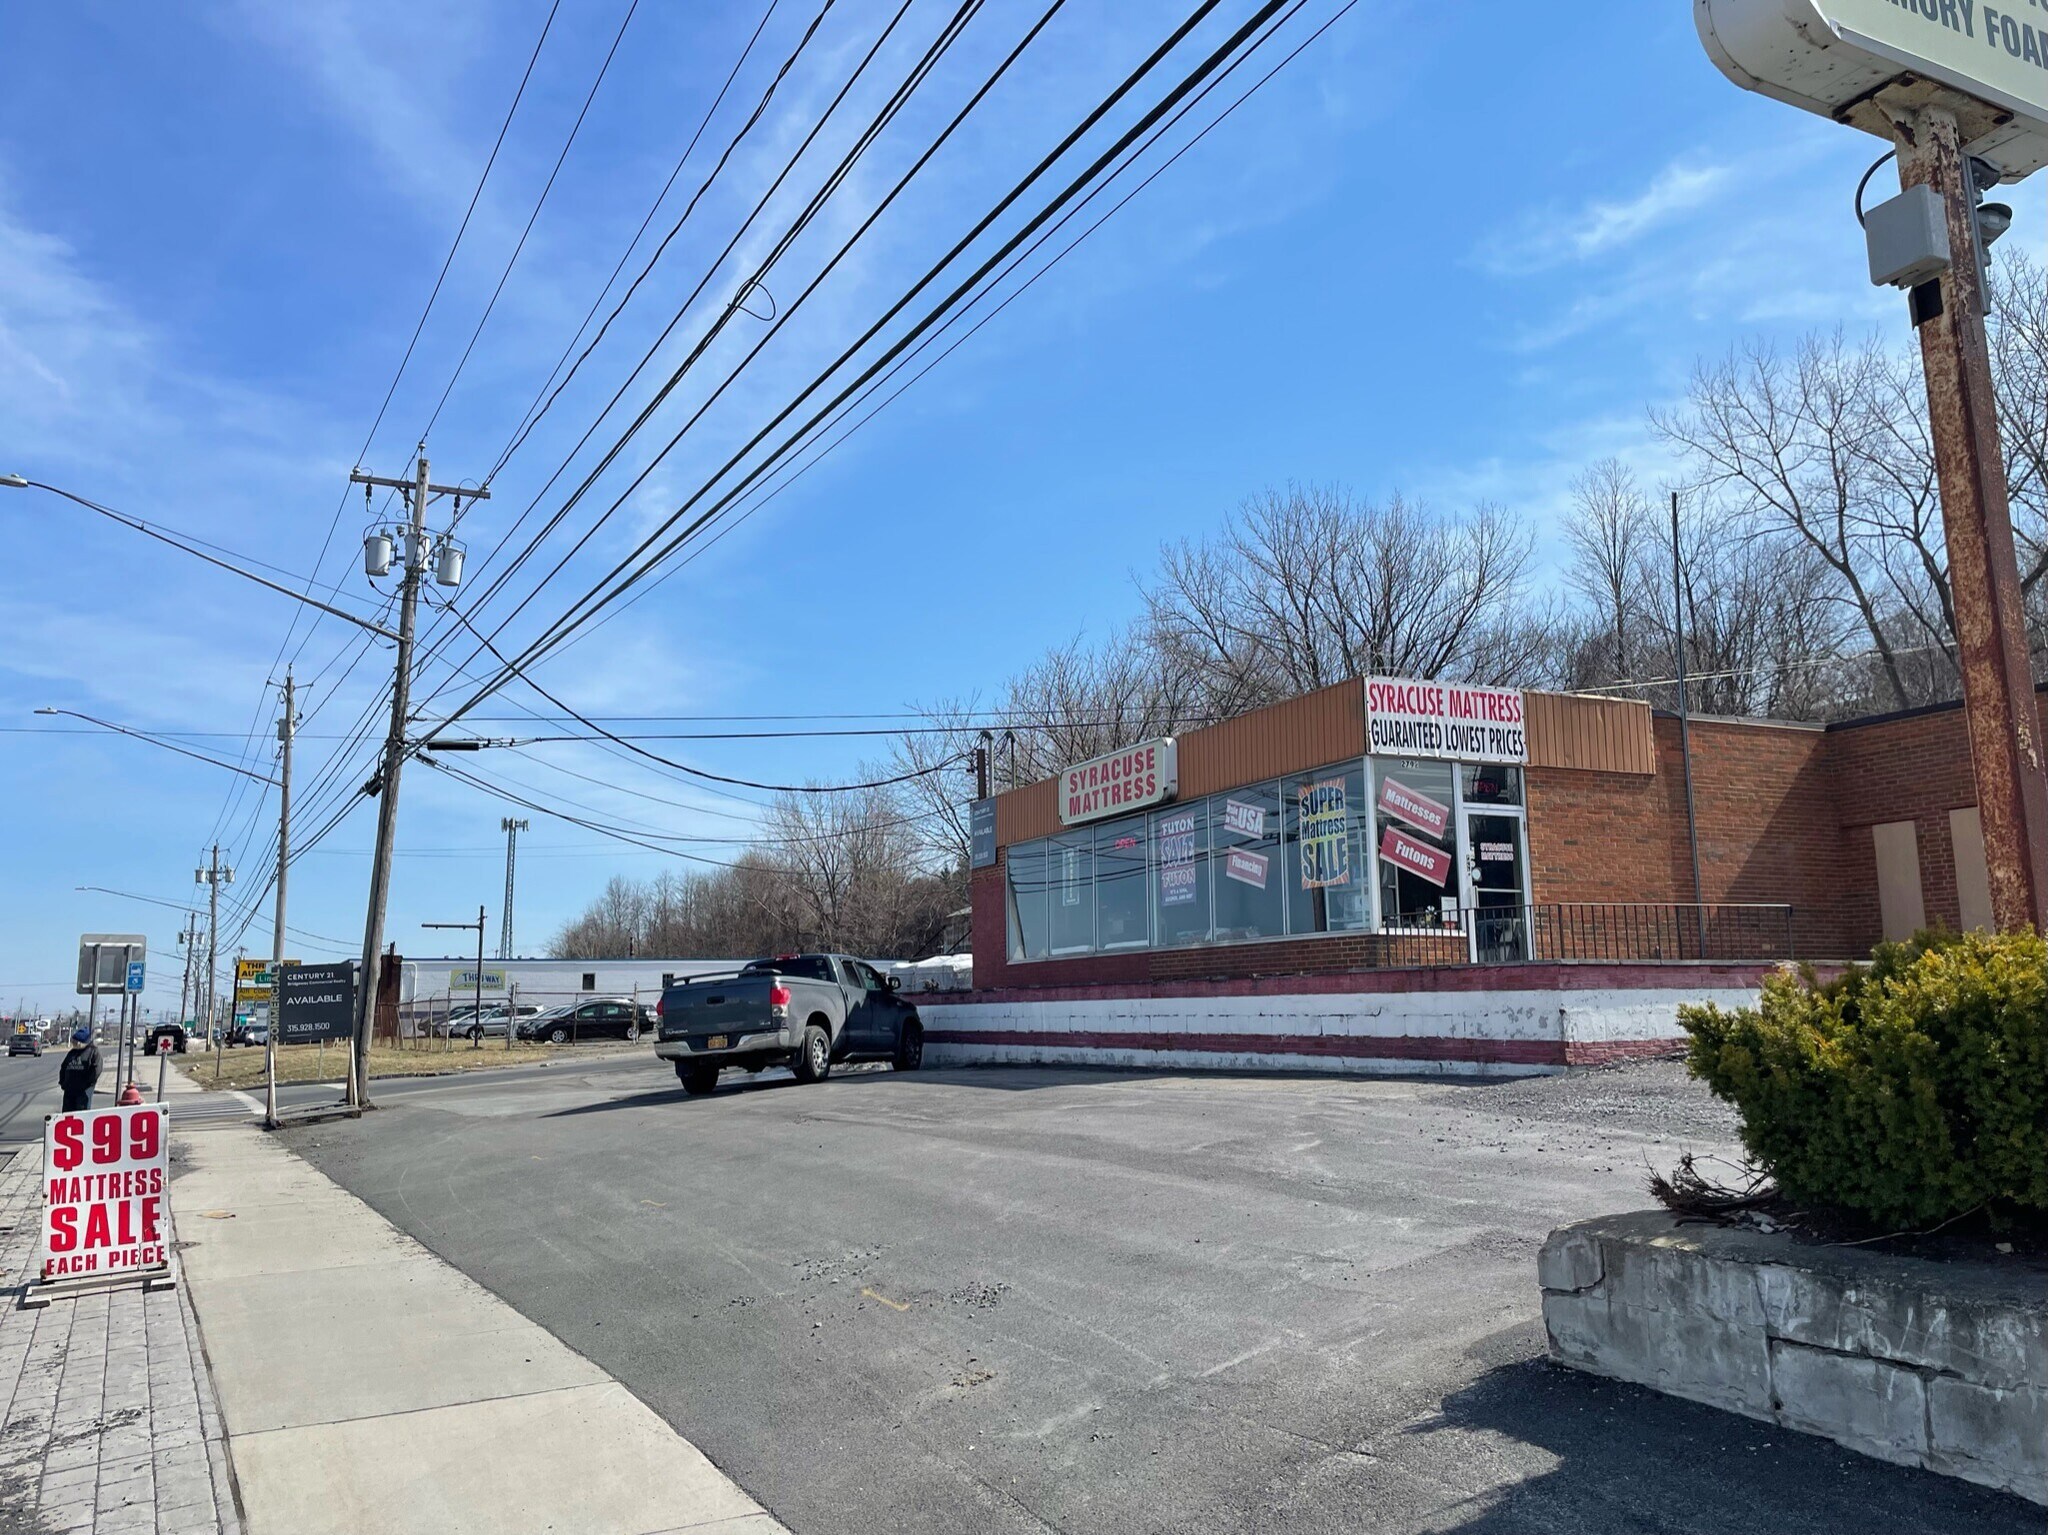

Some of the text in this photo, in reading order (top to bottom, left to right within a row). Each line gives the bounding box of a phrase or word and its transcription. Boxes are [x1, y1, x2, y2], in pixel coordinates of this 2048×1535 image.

[1886, 0, 1974, 38] ORY
[1369, 683, 1521, 723] SYRACUSE MATTRESS
[1371, 719, 1524, 756] GUARANTEED LOWEST PRICES
[1069, 747, 1155, 794] SYRACUSE
[1068, 773, 1156, 817] MATTRESS
[1301, 786, 1344, 818] SUPER
[1385, 788, 1441, 826] Mattresses
[1161, 816, 1195, 836] FUTON
[1237, 806, 1264, 834] USA
[1301, 817, 1345, 840] Mattress
[1114, 837, 1137, 849] OPEN
[1161, 833, 1195, 869] SALE
[1302, 838, 1347, 881] SALE
[1395, 840, 1435, 870] Futons
[1161, 868, 1196, 888] FUTON
[1231, 855, 1263, 877] Financing
[287, 972, 325, 981] CENTURY
[271, 969, 280, 1043] COMMERCIAL
[286, 994, 343, 1006] AVAILABLE
[287, 1022, 330, 1033] 315.928.1500
[53, 1110, 159, 1172] $99
[50, 1168, 162, 1205] MATTRESS
[50, 1196, 161, 1252] SALE
[45, 1245, 165, 1276] EACH PIECE
